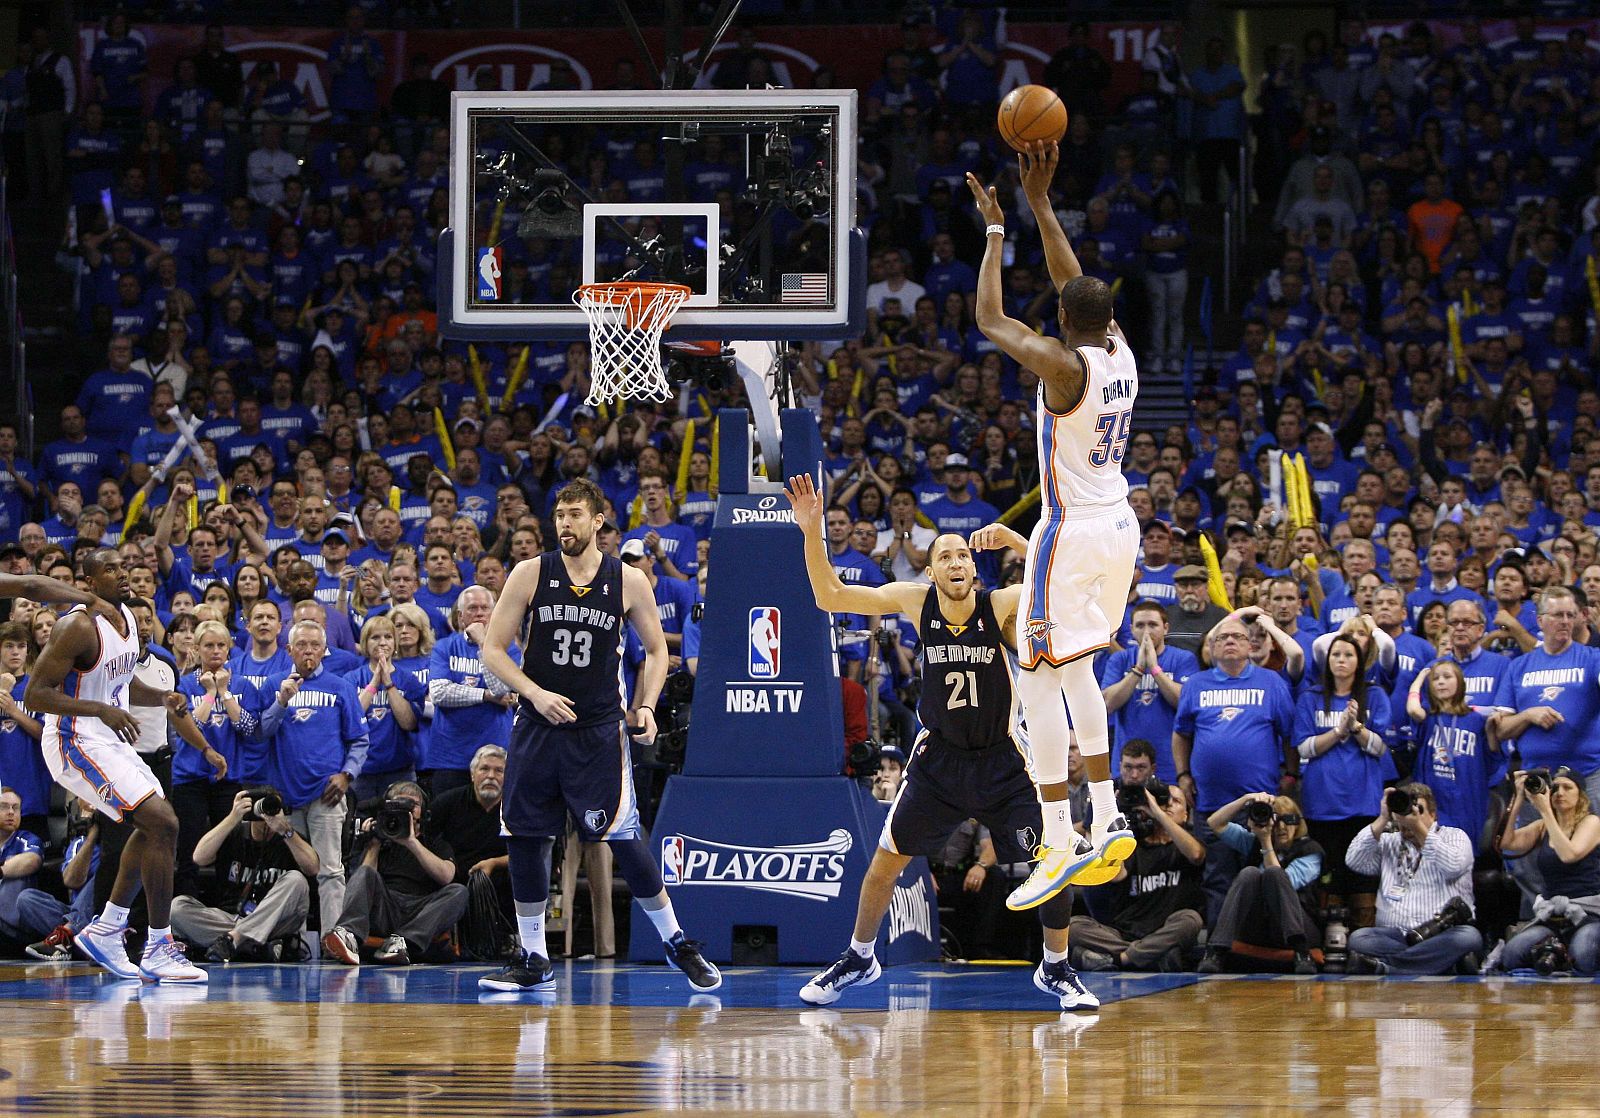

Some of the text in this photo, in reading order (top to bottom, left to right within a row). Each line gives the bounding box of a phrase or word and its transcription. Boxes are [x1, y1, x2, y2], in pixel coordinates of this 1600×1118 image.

[480, 289, 495, 297] NBA
[104, 384, 145, 395] COMMUNITY
[1102, 379, 1134, 405] DURANT
[261, 417, 303, 431] COMMUNITY
[1088, 408, 1133, 469] 35
[57, 452, 99, 465] COMMUNITY
[538, 604, 616, 631] MEMPHIS
[551, 628, 593, 668] 33
[926, 645, 996, 665] MEMPHIS
[752, 663, 770, 673] NBA
[1522, 667, 1585, 687] COMMUNITY
[725, 689, 803, 713] NBA TV
[945, 671, 980, 711] 21
[1200, 689, 1265, 707] COMMUNITY
[684, 850, 846, 881] PLAYOFFS
